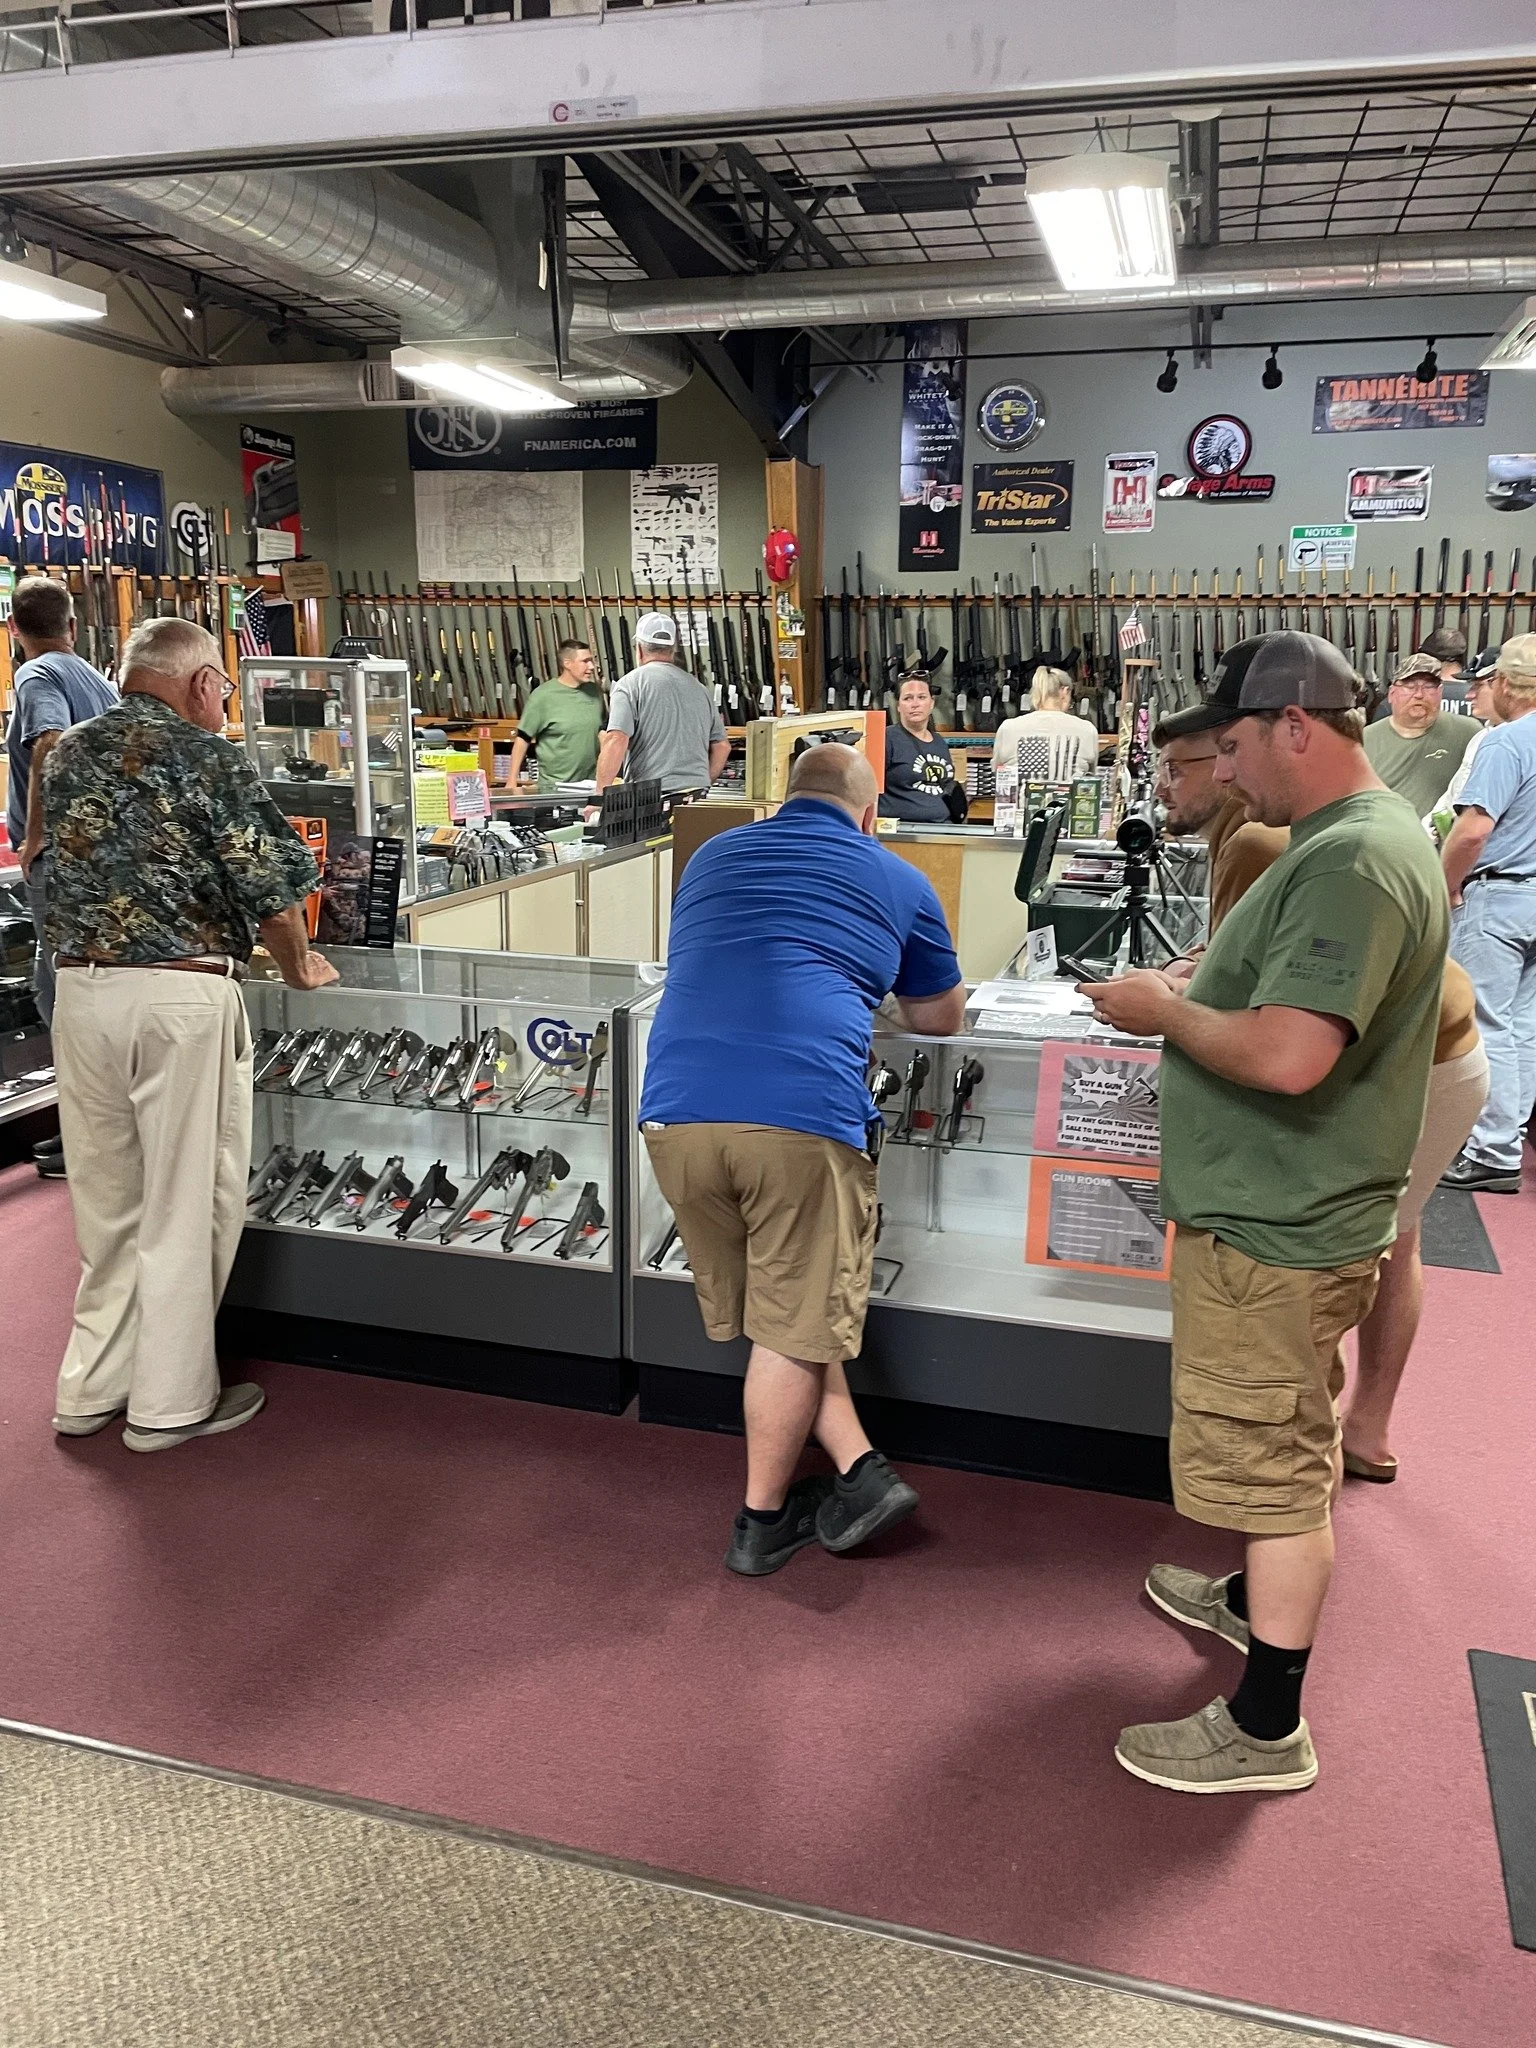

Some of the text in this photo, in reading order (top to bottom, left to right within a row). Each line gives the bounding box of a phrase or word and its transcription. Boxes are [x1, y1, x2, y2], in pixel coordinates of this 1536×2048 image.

[1330, 374, 1469, 401] TANNERITE
[594, 408, 645, 418] FIREARMS
[524, 437, 637, 451] FNAMERICA.COM
[1223, 474, 1272, 490] Arms
[977, 488, 1056, 510] TriStar
[1350, 498, 1424, 511] AMMUNITION
[1025, 517, 1057, 525] Experts
[1304, 527, 1343, 537] NOTICE
[527, 1017, 594, 1065] COLT
[1104, 1082, 1122, 1090] GUN
[1052, 1173, 1112, 1187] GUN ROOM
